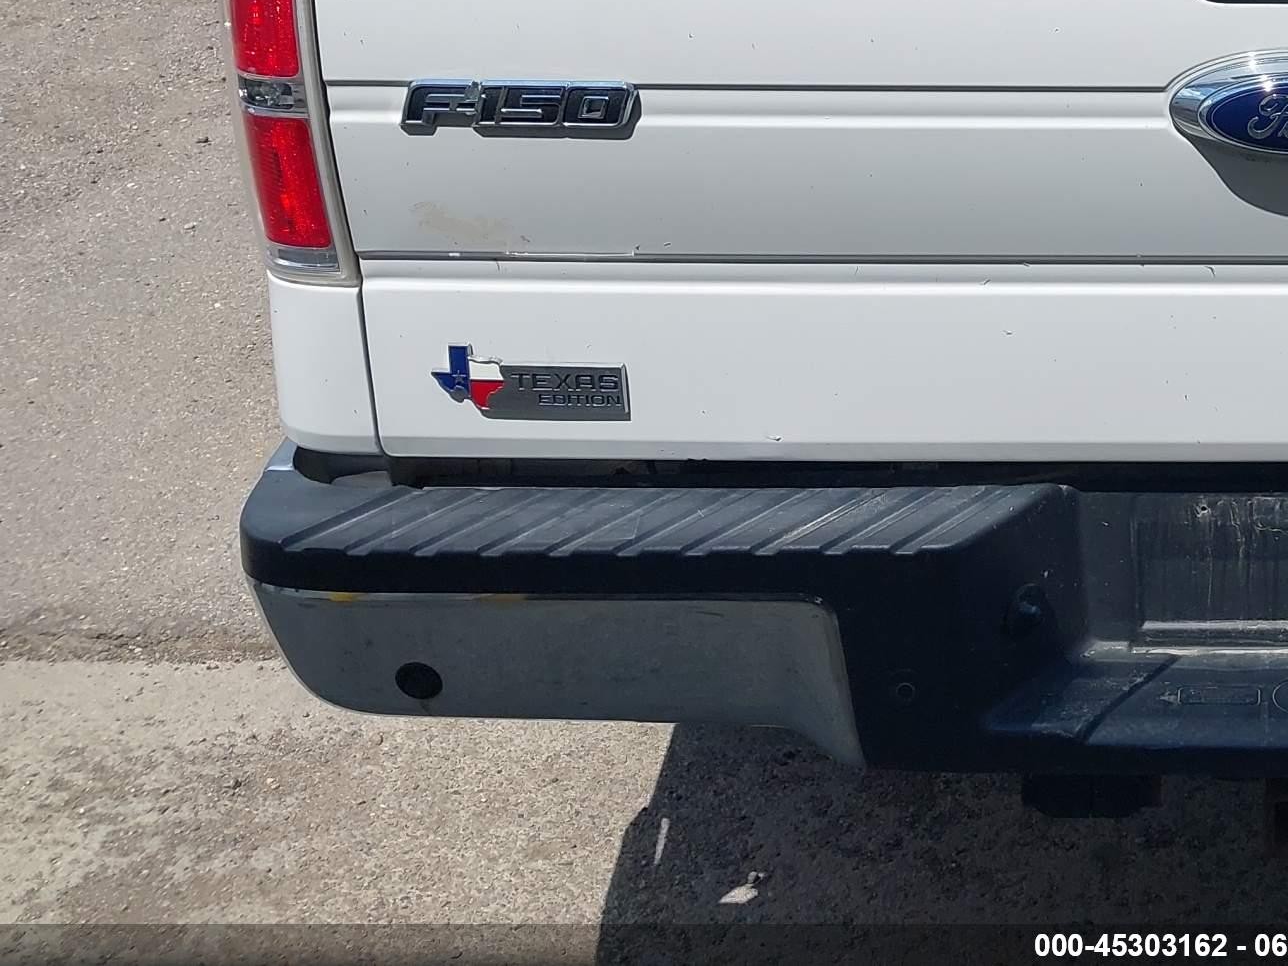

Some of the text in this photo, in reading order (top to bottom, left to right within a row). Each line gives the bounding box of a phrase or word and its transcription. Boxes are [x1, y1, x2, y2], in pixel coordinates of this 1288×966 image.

[401, 79, 640, 140] F-150
[510, 372, 619, 392] TEXAS
[539, 394, 622, 407] EDITION
